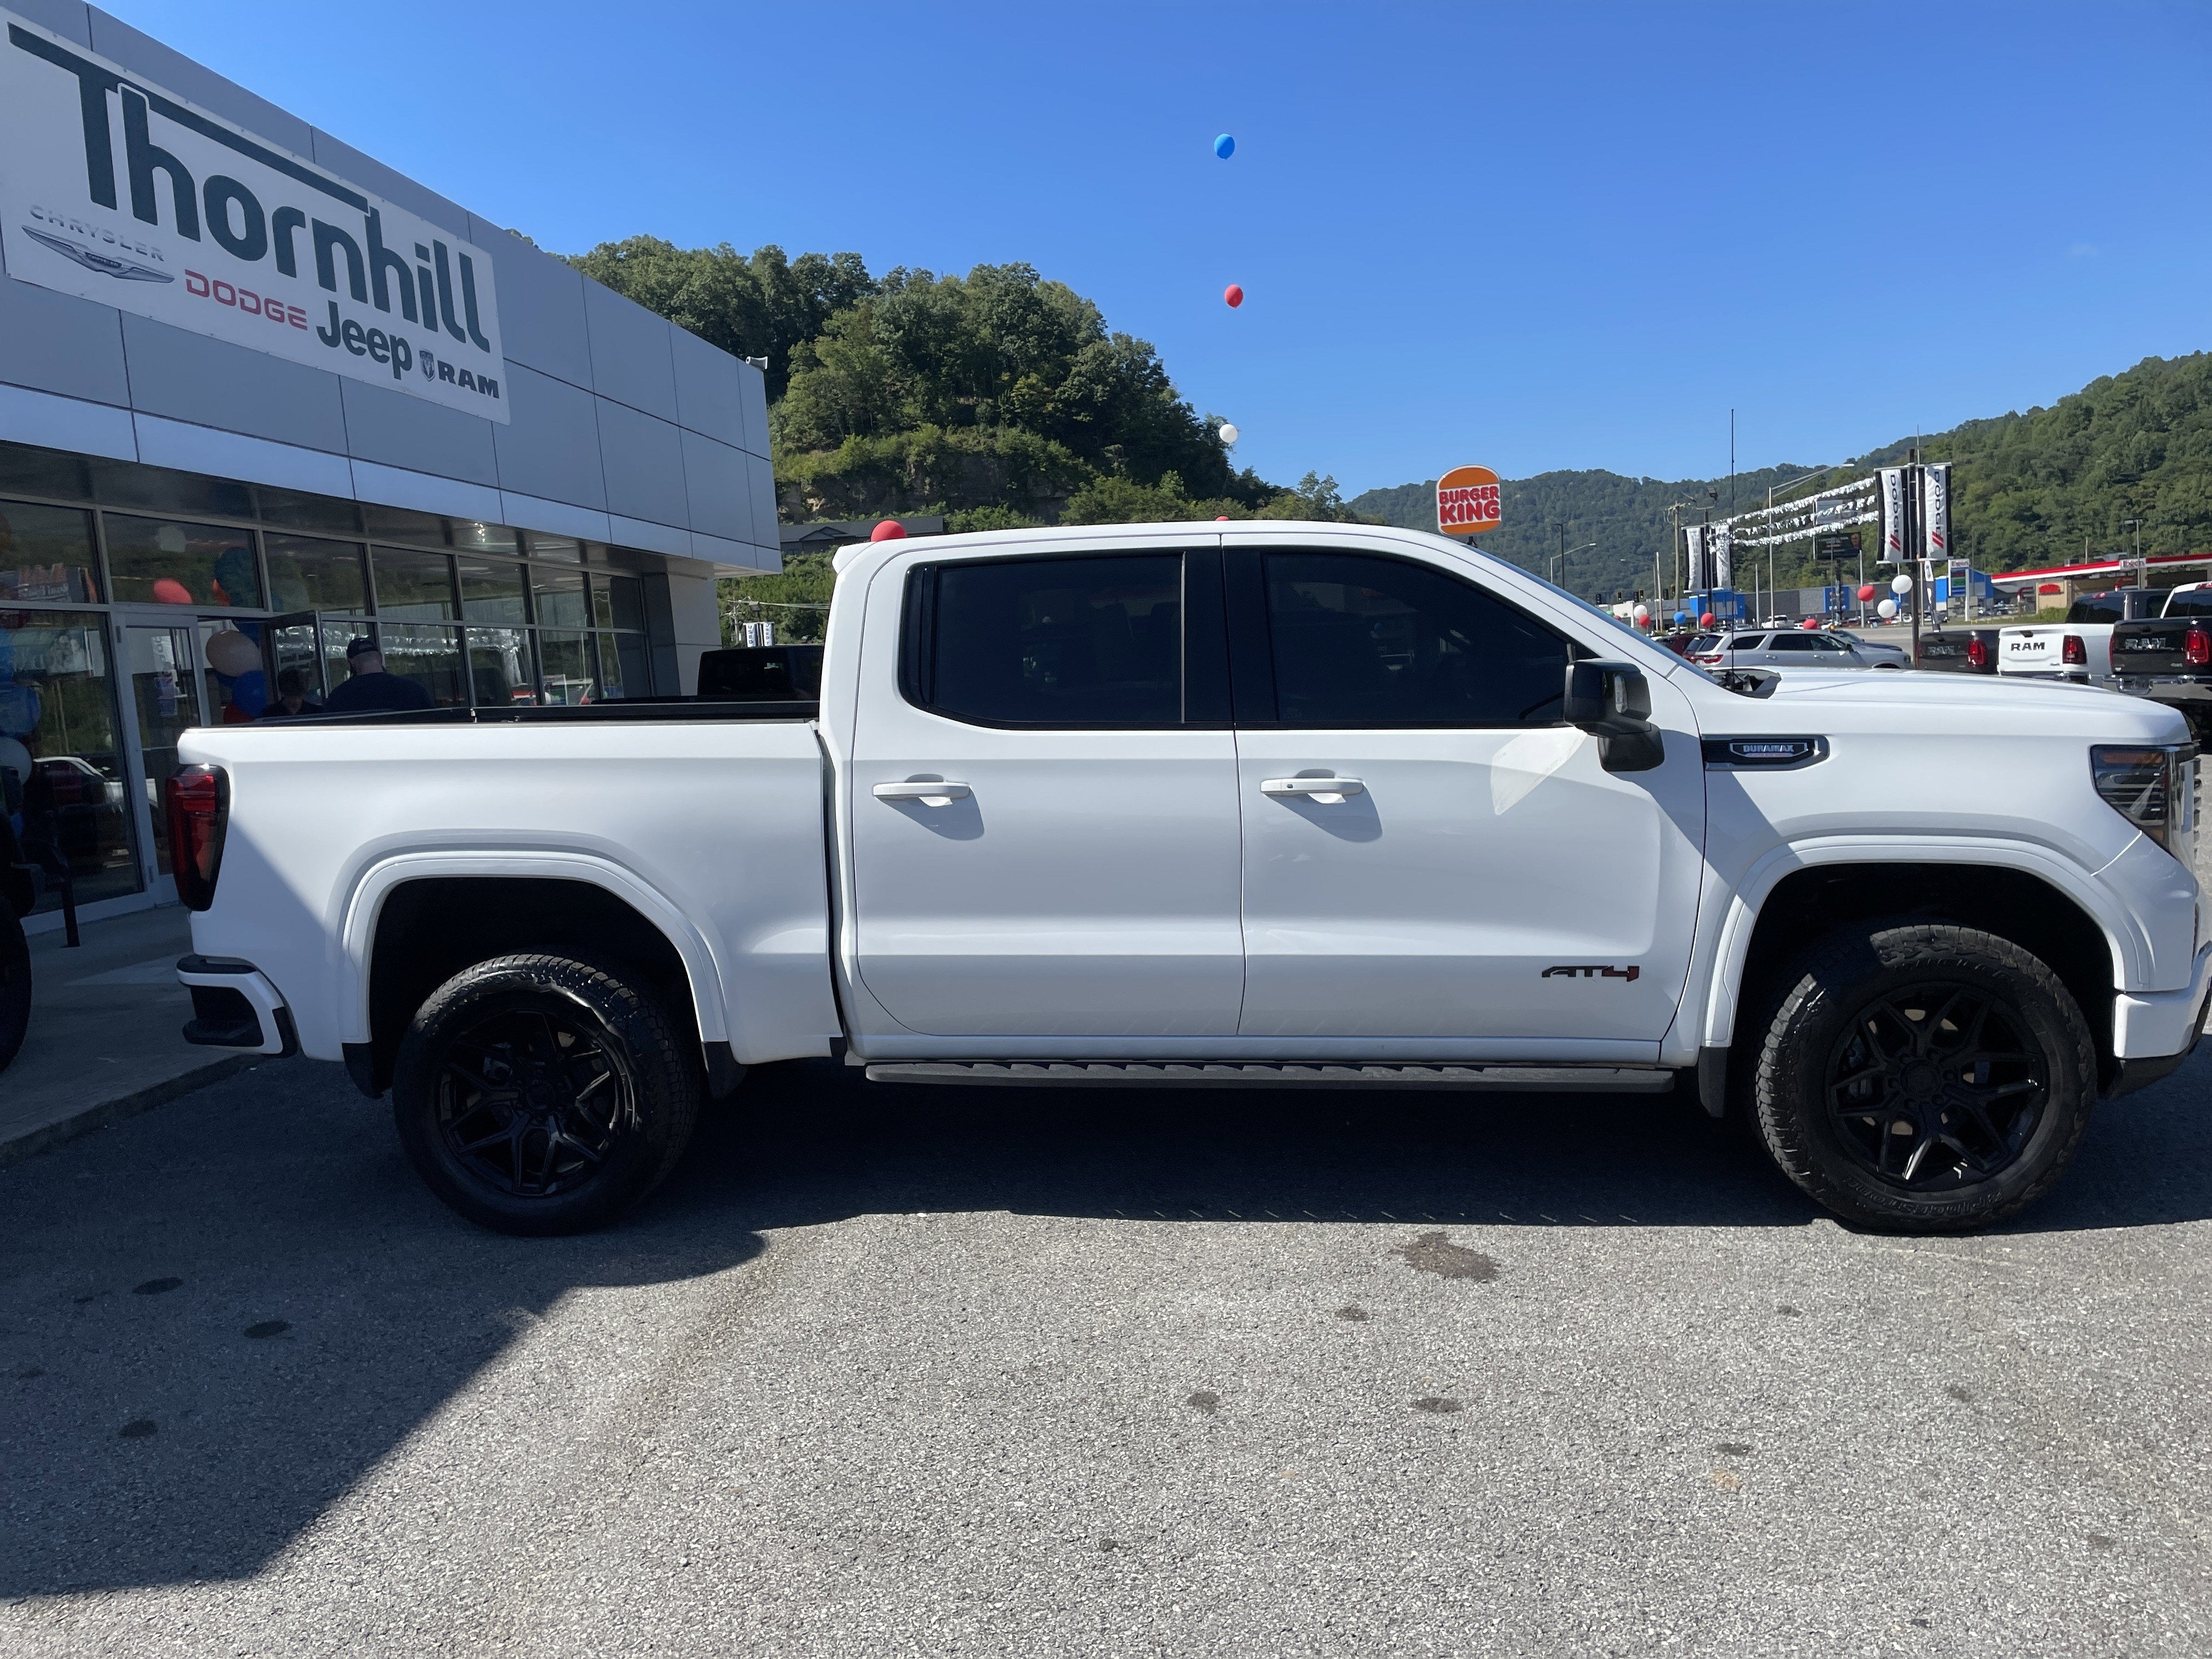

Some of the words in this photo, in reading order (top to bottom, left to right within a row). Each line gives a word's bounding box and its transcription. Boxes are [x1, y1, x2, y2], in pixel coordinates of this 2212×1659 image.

[8, 22, 490, 353] Thornhill
[29, 204, 165, 262] CHRYSLER
[185, 269, 308, 331] DODGE
[316, 301, 413, 380] Jeep
[438, 359, 500, 399] RAM
[1439, 486, 1500, 505] BURGER
[1440, 499, 1501, 524] KING
[1890, 474, 1899, 539] DODGE
[2010, 642, 2045, 651] RAM
[1742, 744, 1795, 753] DURAMAX
[1542, 965, 1640, 982] AT4
